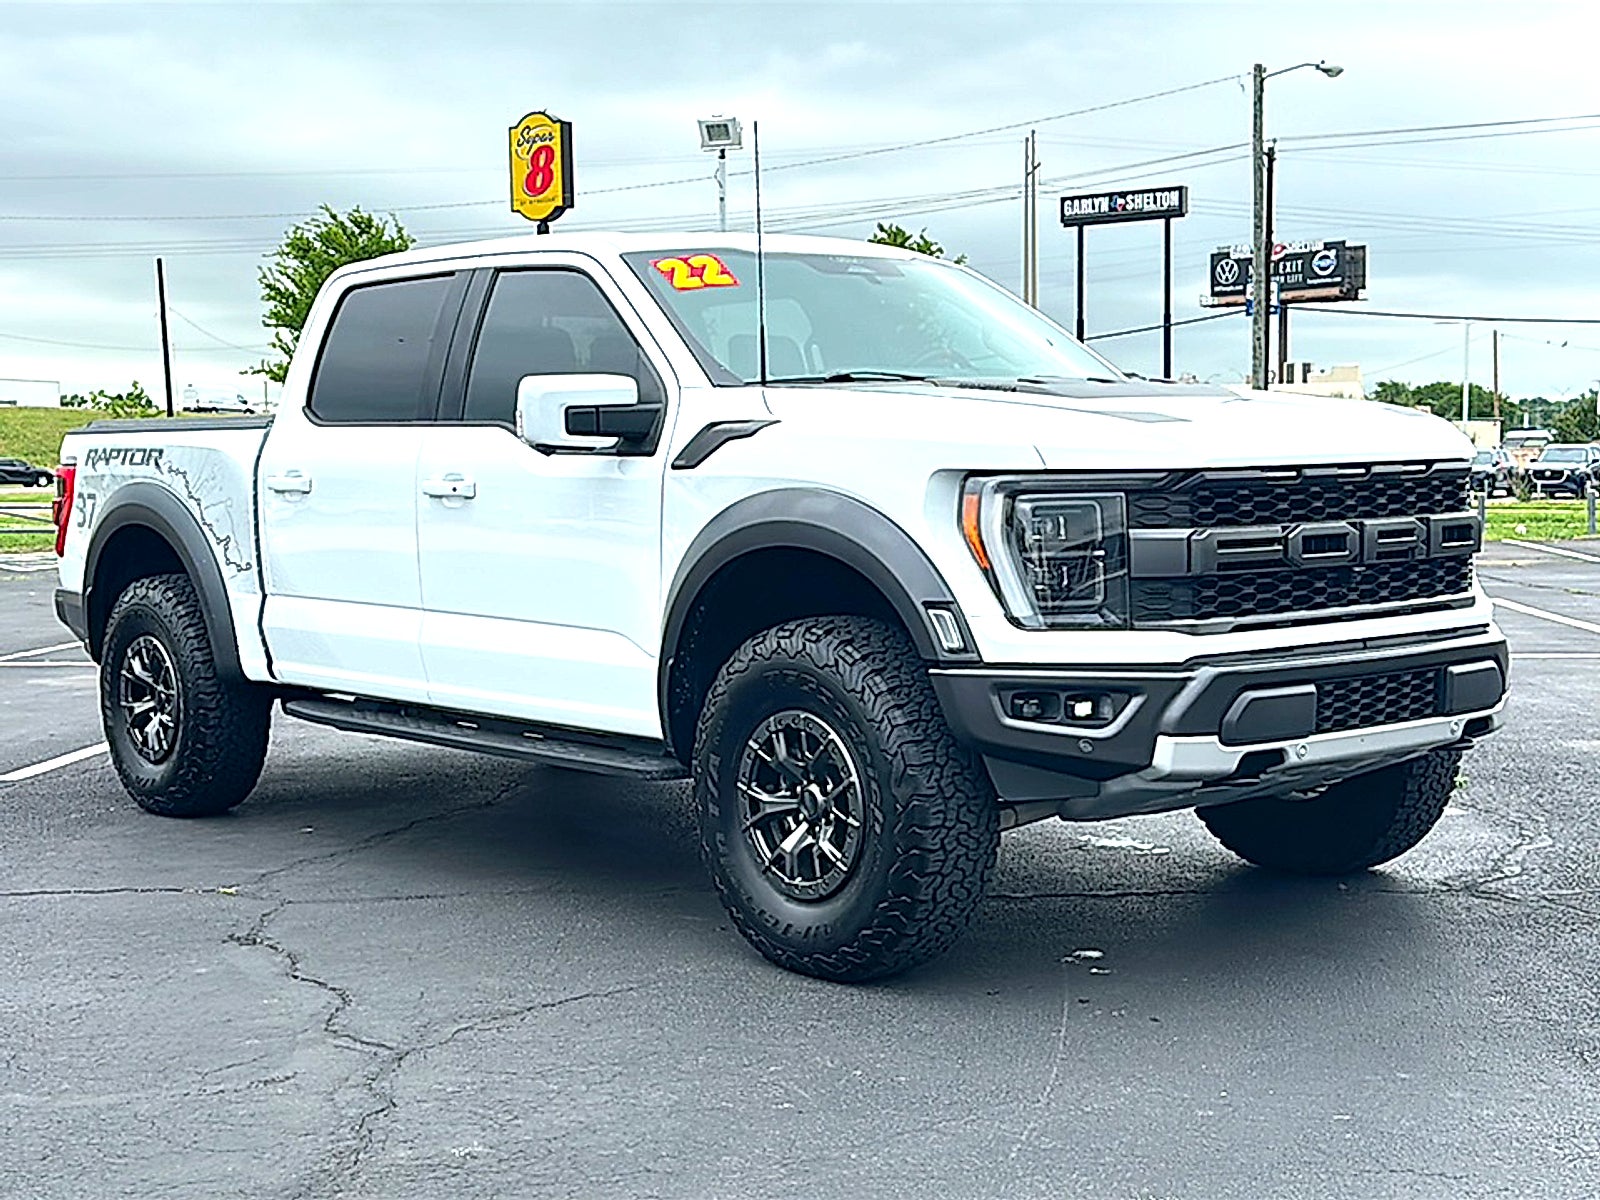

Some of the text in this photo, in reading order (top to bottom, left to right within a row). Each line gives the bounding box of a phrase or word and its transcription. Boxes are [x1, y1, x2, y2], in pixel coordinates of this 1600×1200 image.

[517, 125, 555, 155] Super
[524, 144, 555, 197] 8
[1063, 190, 1180, 216] GARLYN SHELTON
[655, 254, 734, 289] 22
[1279, 259, 1304, 274] EXIT
[85, 448, 163, 475] RAPTOR
[77, 492, 97, 529] 37
[1191, 515, 1481, 575] FORD
